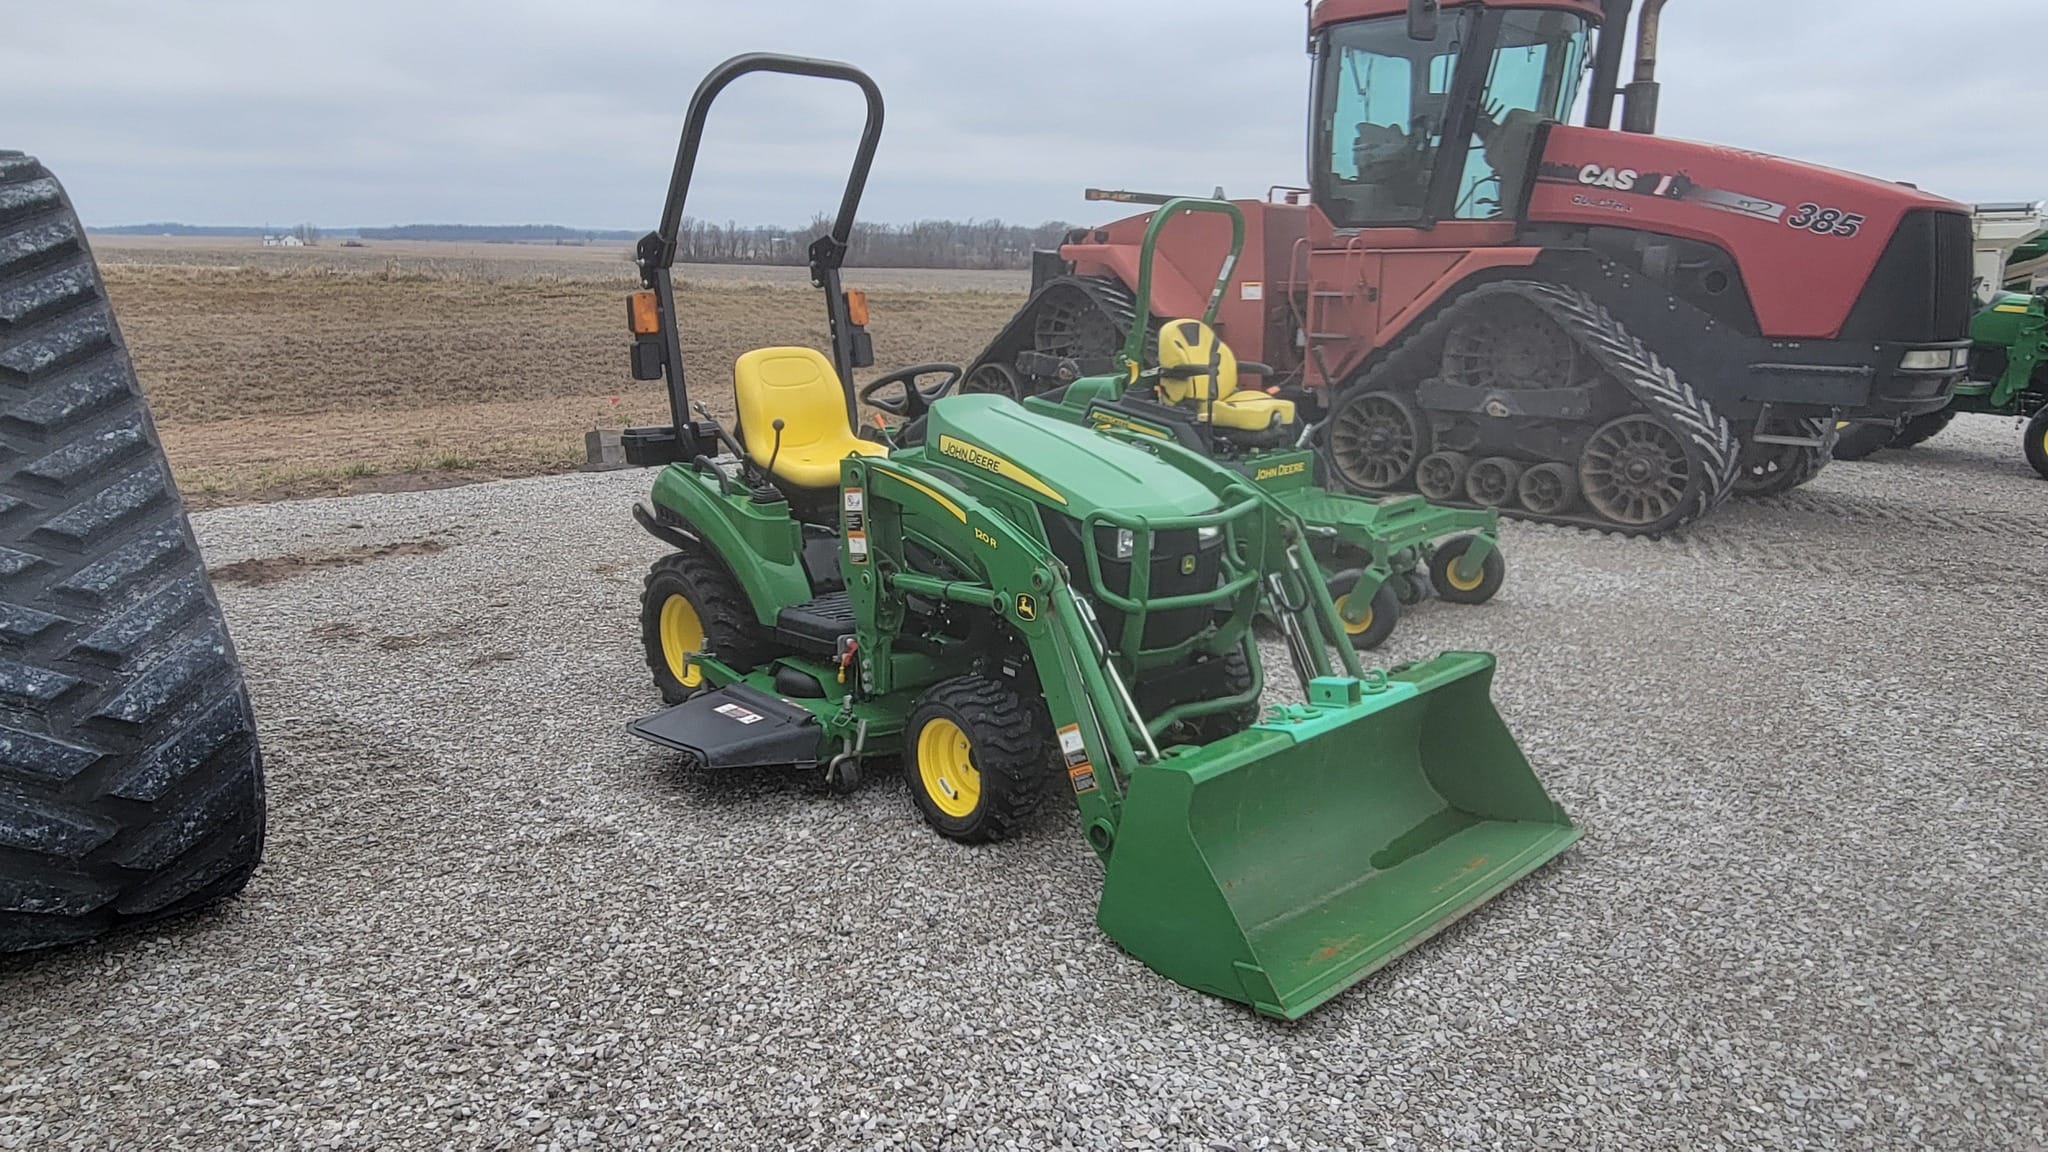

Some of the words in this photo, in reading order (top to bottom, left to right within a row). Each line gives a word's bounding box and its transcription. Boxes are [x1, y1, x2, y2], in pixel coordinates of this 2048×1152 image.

[1787, 202, 1866, 238] 385
[943, 441, 968, 463] JOHN
[968, 449, 1001, 473] DEERE
[1254, 466, 1278, 481] JOHN
[1278, 461, 1306, 477] DEERE
